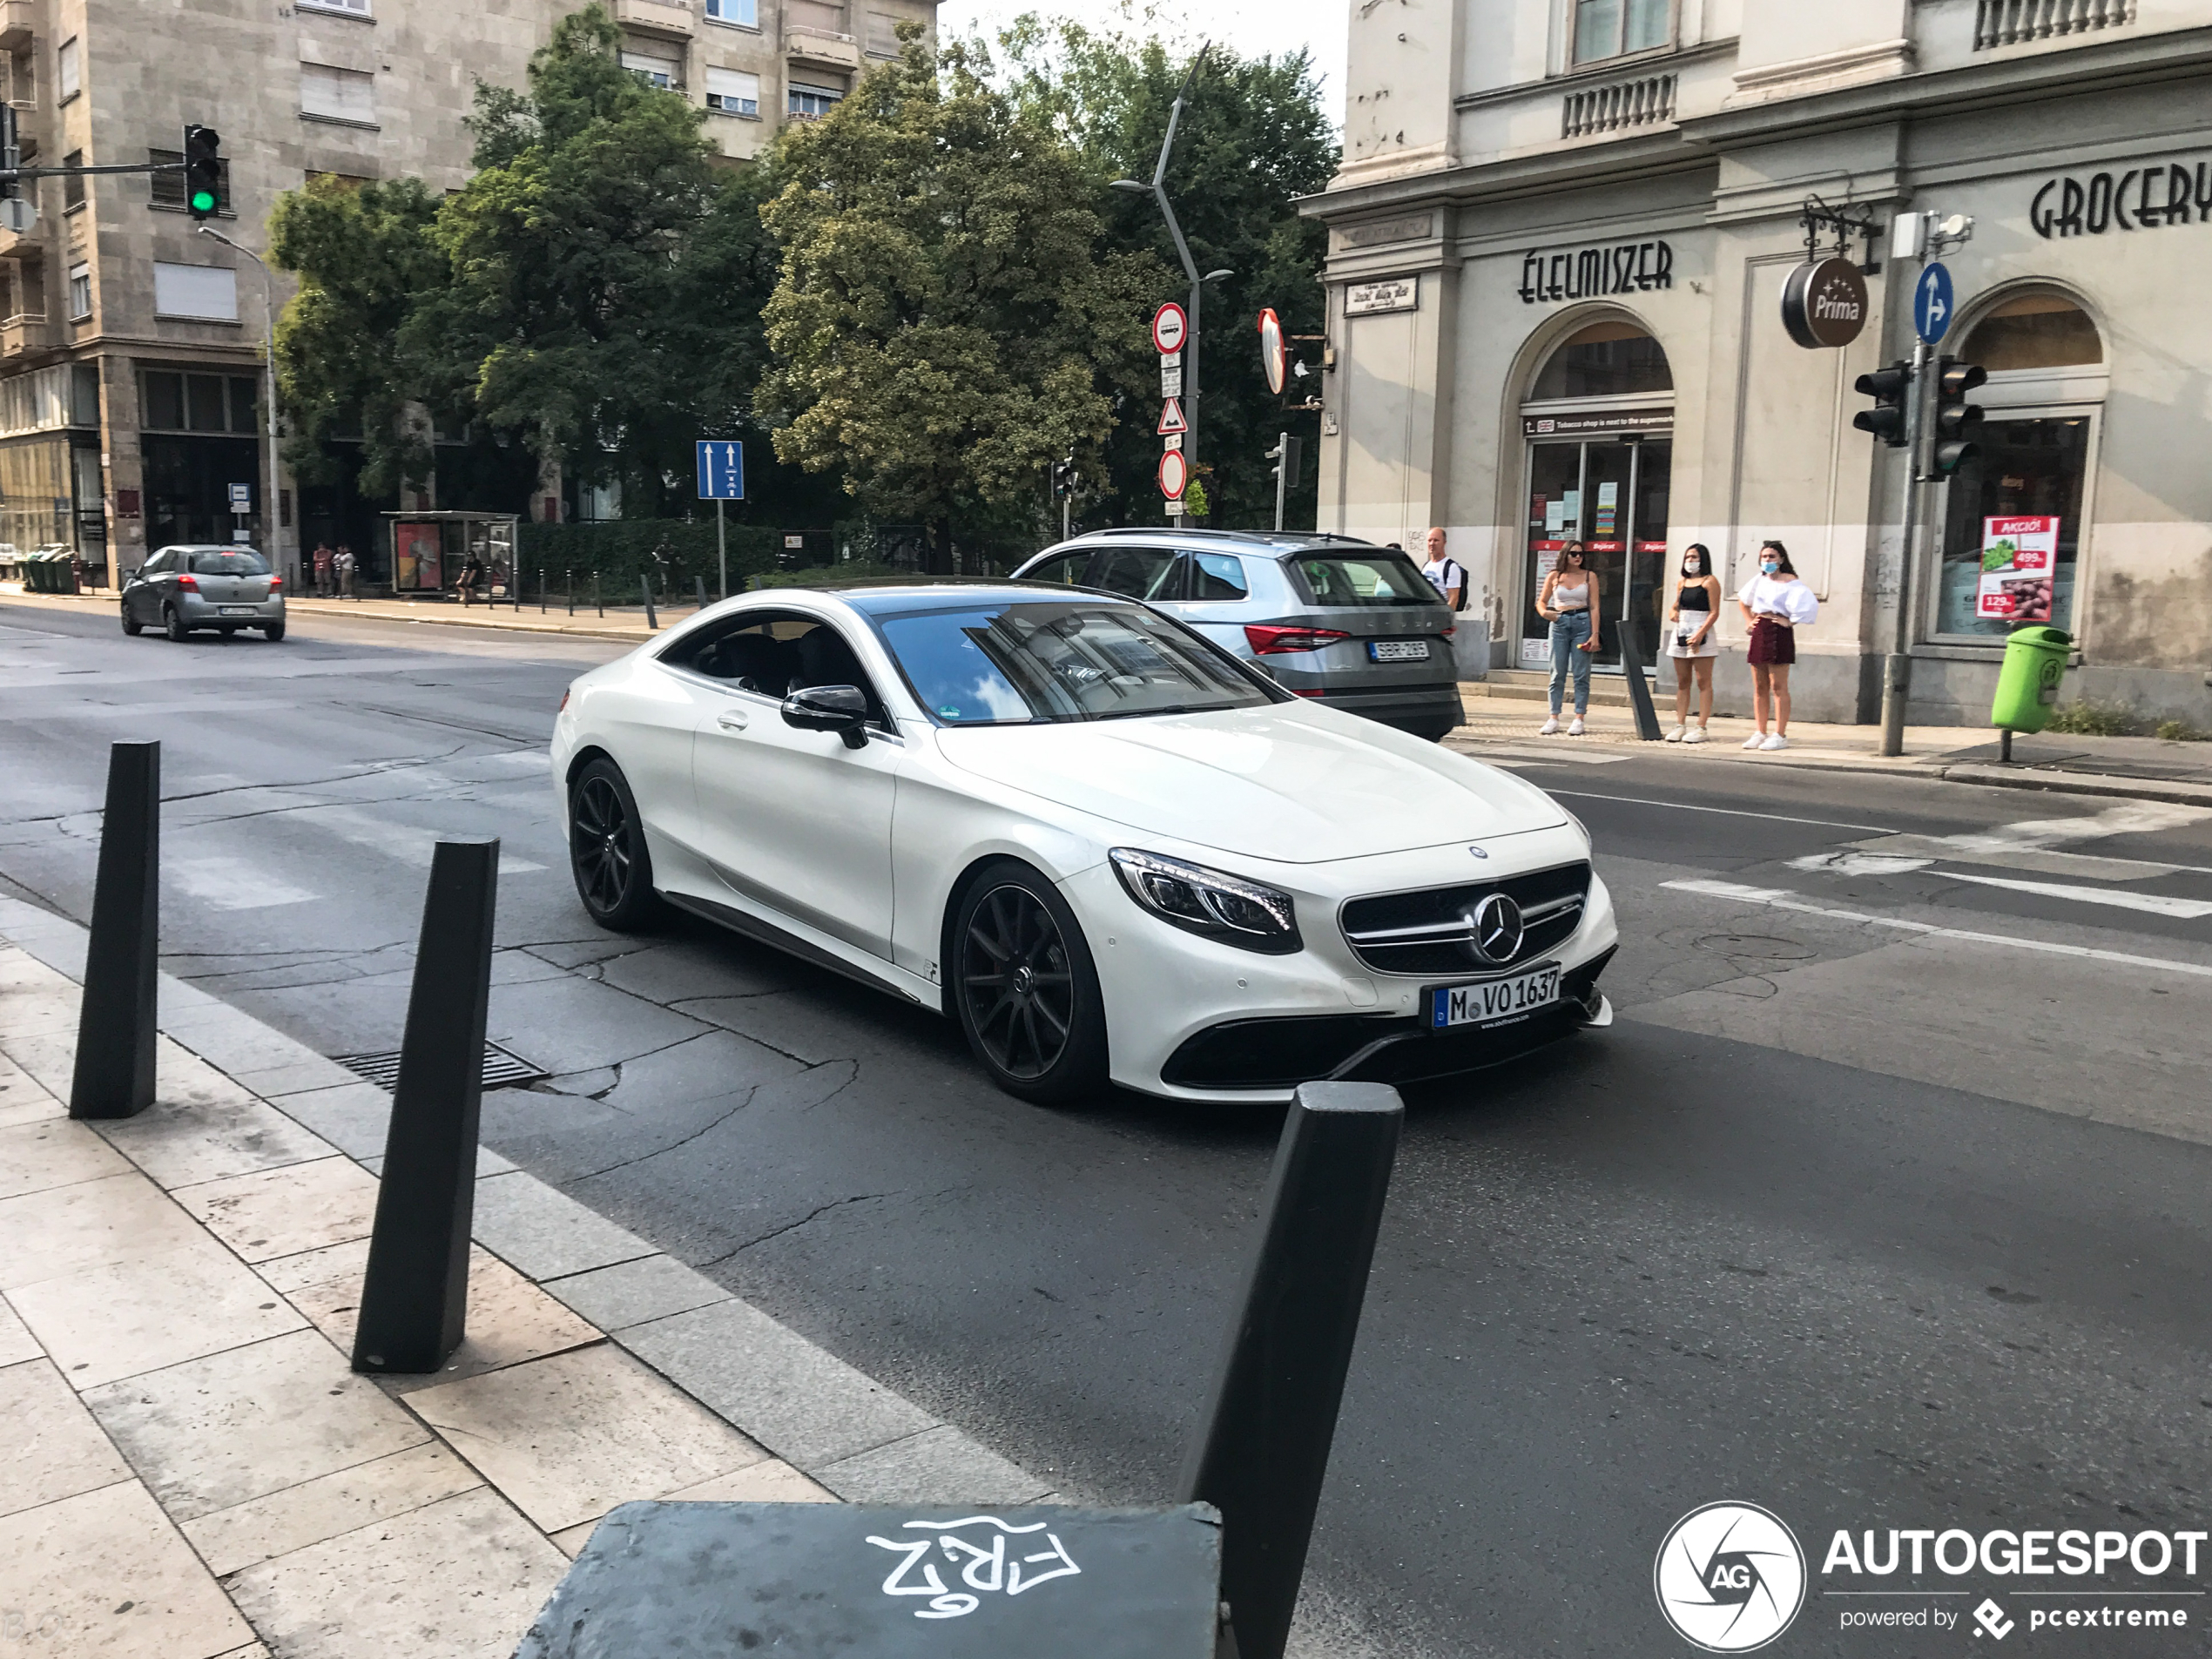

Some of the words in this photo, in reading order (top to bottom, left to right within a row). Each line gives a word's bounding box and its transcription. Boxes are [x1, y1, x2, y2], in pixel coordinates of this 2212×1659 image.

[2030, 162, 2212, 239] GROCERY
[1518, 239, 1673, 304] ÉLELMISZER
[1582, 420, 1598, 428] shop
[2000, 518, 2041, 534] AKCIÓ!
[1986, 596, 2007, 607] 129
[1450, 990, 1467, 1022] M
[1514, 968, 1559, 1009] 1637
